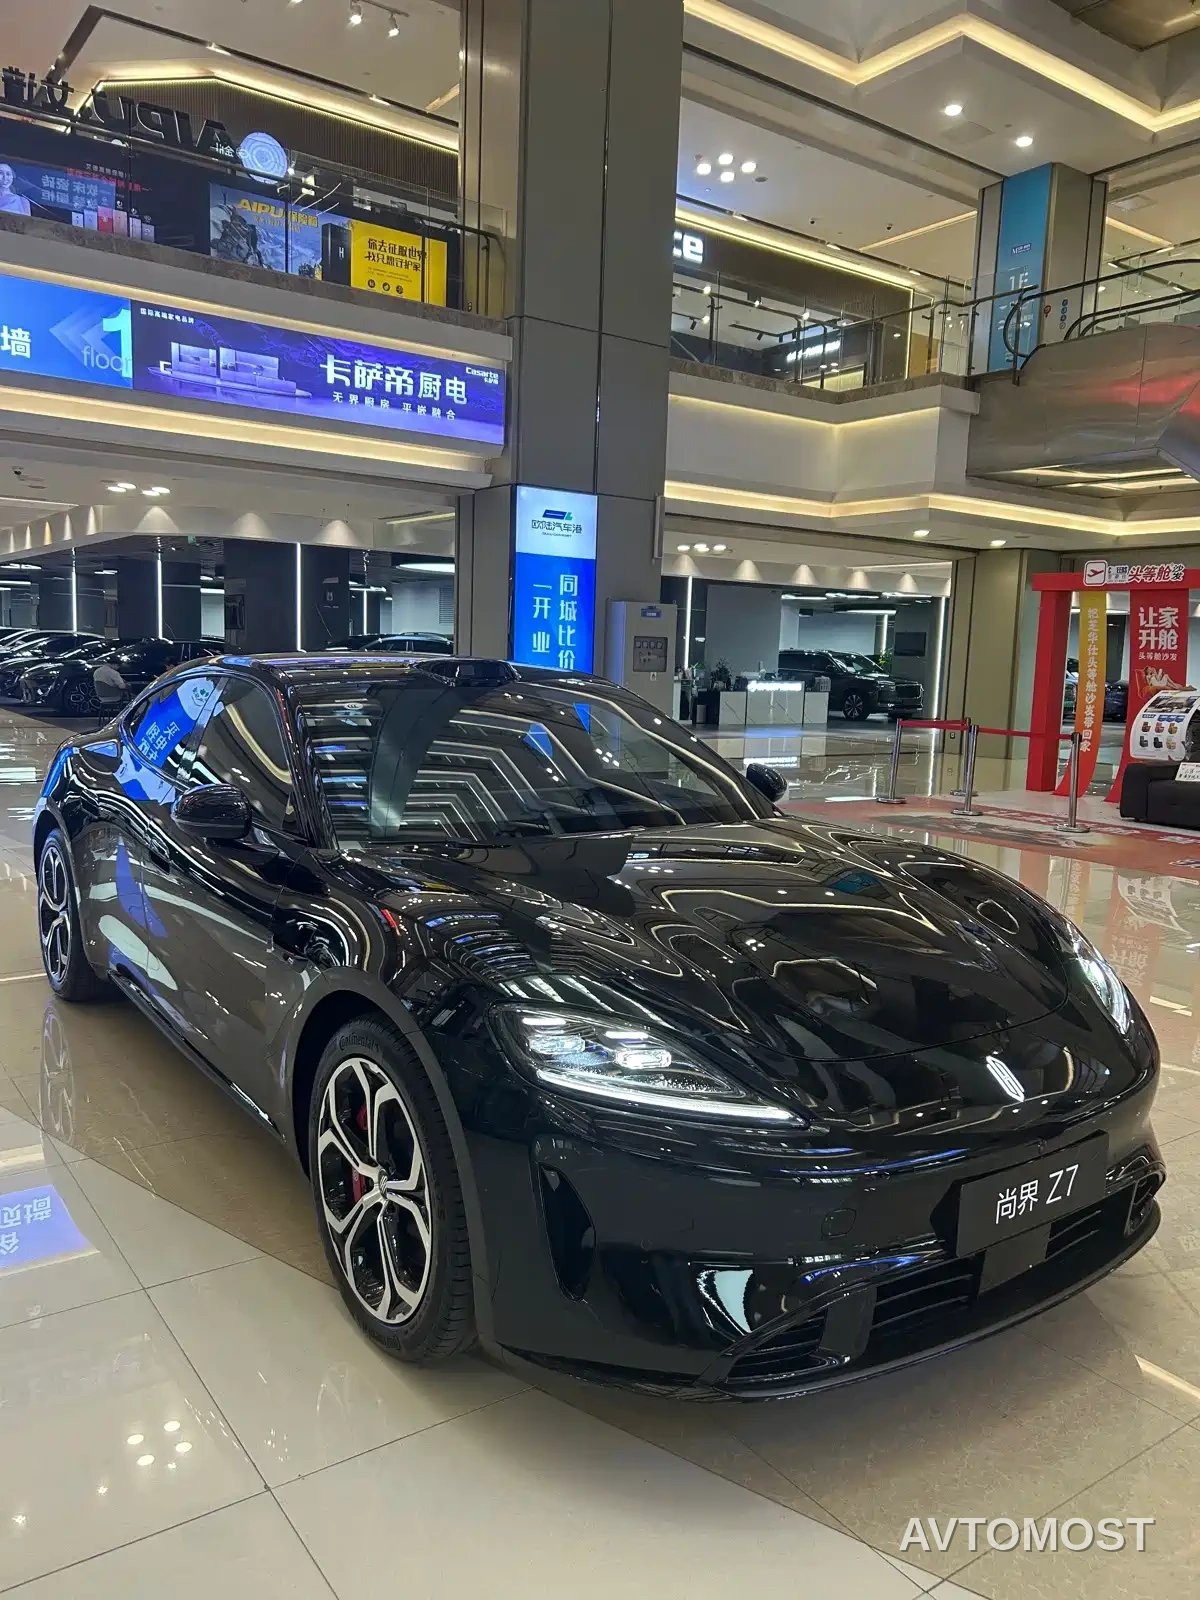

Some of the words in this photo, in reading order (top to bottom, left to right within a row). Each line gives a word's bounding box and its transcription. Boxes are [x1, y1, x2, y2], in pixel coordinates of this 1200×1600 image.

[238, 198, 284, 219] AIPU
[0, 325, 31, 359] 墙
[465, 366, 499, 380] Casarte
[332, 391, 391, 411] 无界厨房
[402, 402, 456, 421] 平嵌融合
[531, 519, 582, 534] 欧陆汽车港
[1129, 564, 1171, 583] 头等舱
[558, 574, 578, 670] 同城比价
[1138, 606, 1179, 628] 让家
[1138, 629, 1178, 650] 升舱
[1138, 652, 1178, 661] 头等舱沙发
[995, 1179, 1039, 1225] 尚界
[1045, 1163, 1079, 1205] Z7
